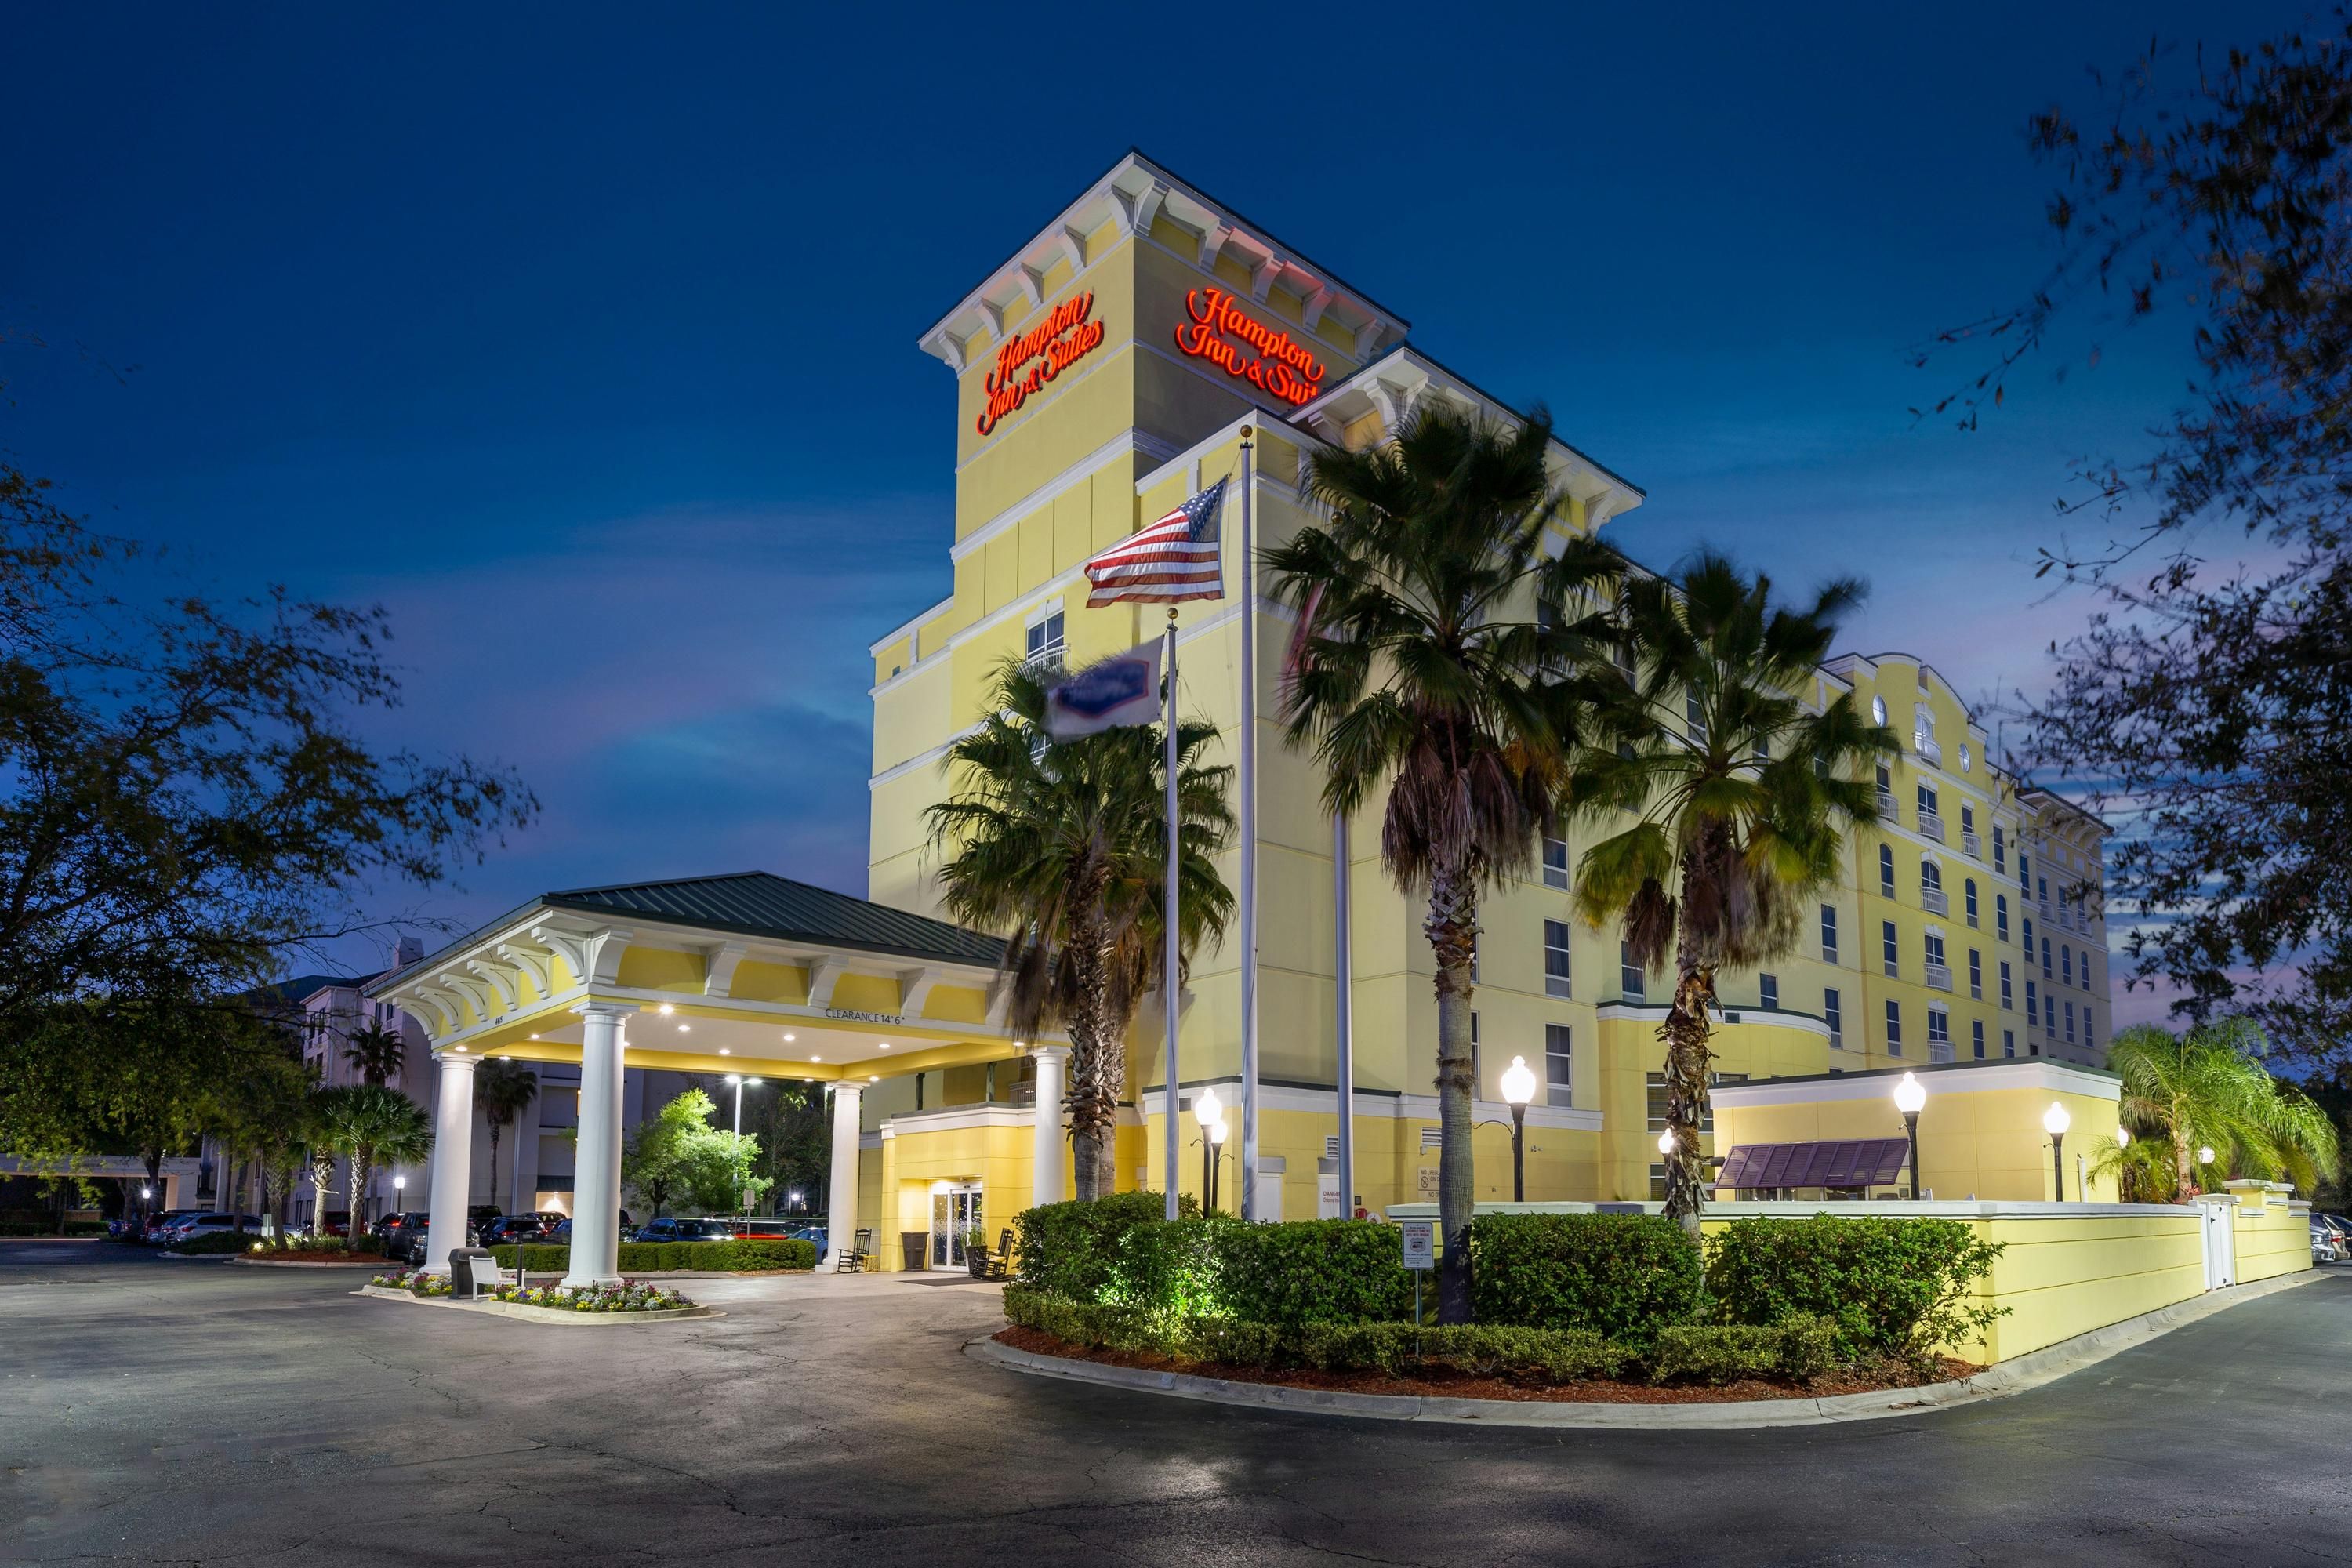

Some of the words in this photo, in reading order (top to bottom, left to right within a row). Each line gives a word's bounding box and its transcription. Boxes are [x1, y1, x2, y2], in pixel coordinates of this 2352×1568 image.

[975, 380, 1028, 436] Inn
[1024, 366, 1043, 394] &
[1039, 318, 1105, 382] Suites
[984, 290, 1094, 395] Hampton
[1174, 322, 1247, 377] Inn
[1245, 358, 1265, 390] &
[1185, 287, 1326, 383] Hampton
[825, 1008, 880, 1023] CLEARANCE
